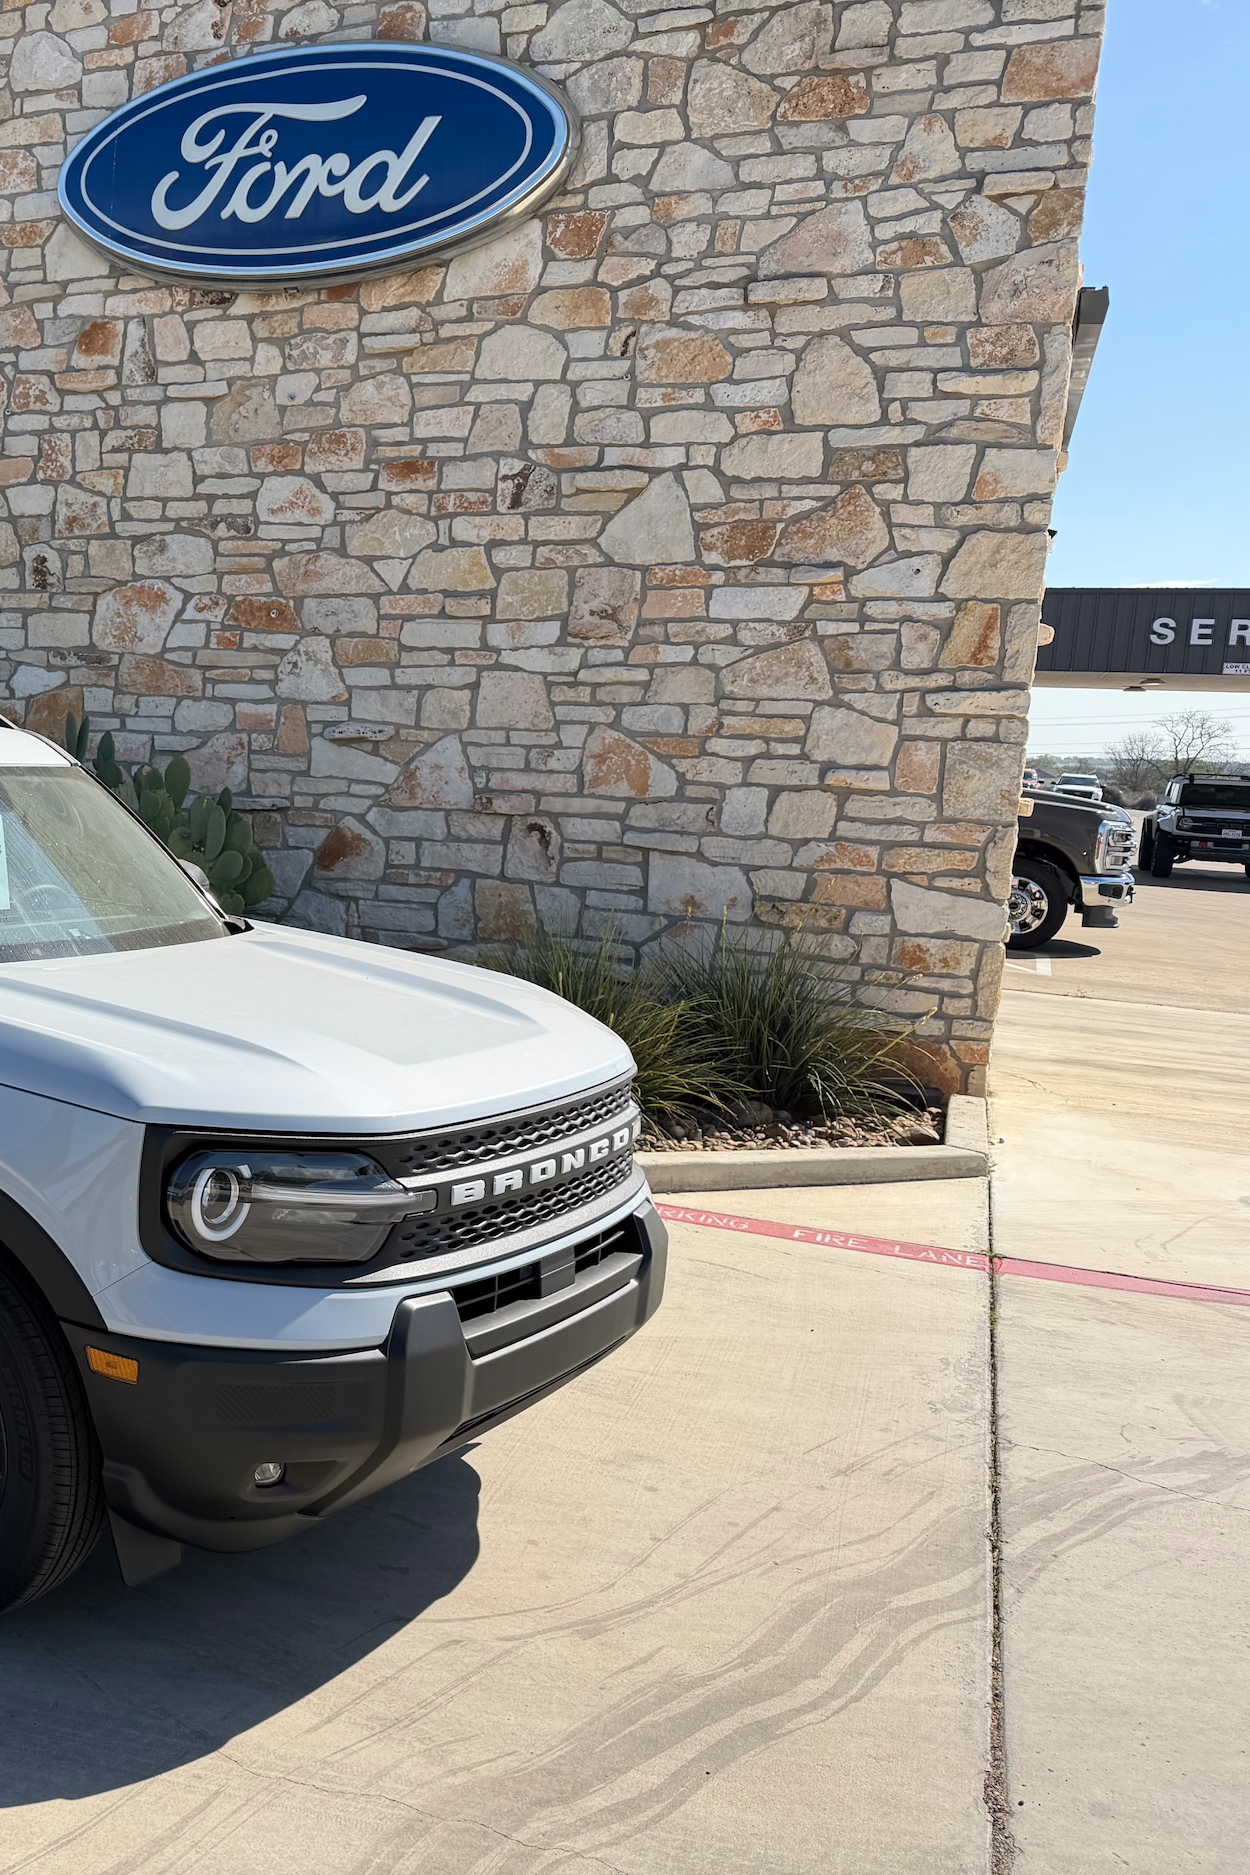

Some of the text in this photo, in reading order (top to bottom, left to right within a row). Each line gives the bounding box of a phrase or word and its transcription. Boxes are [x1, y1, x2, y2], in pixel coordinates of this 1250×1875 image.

[151, 94, 442, 231] Ford
[1150, 617, 1250, 646] SER
[451, 1126, 630, 1206] BRONCO
[792, 1229, 869, 1250] FIRE
[893, 1245, 987, 1268] LANE
